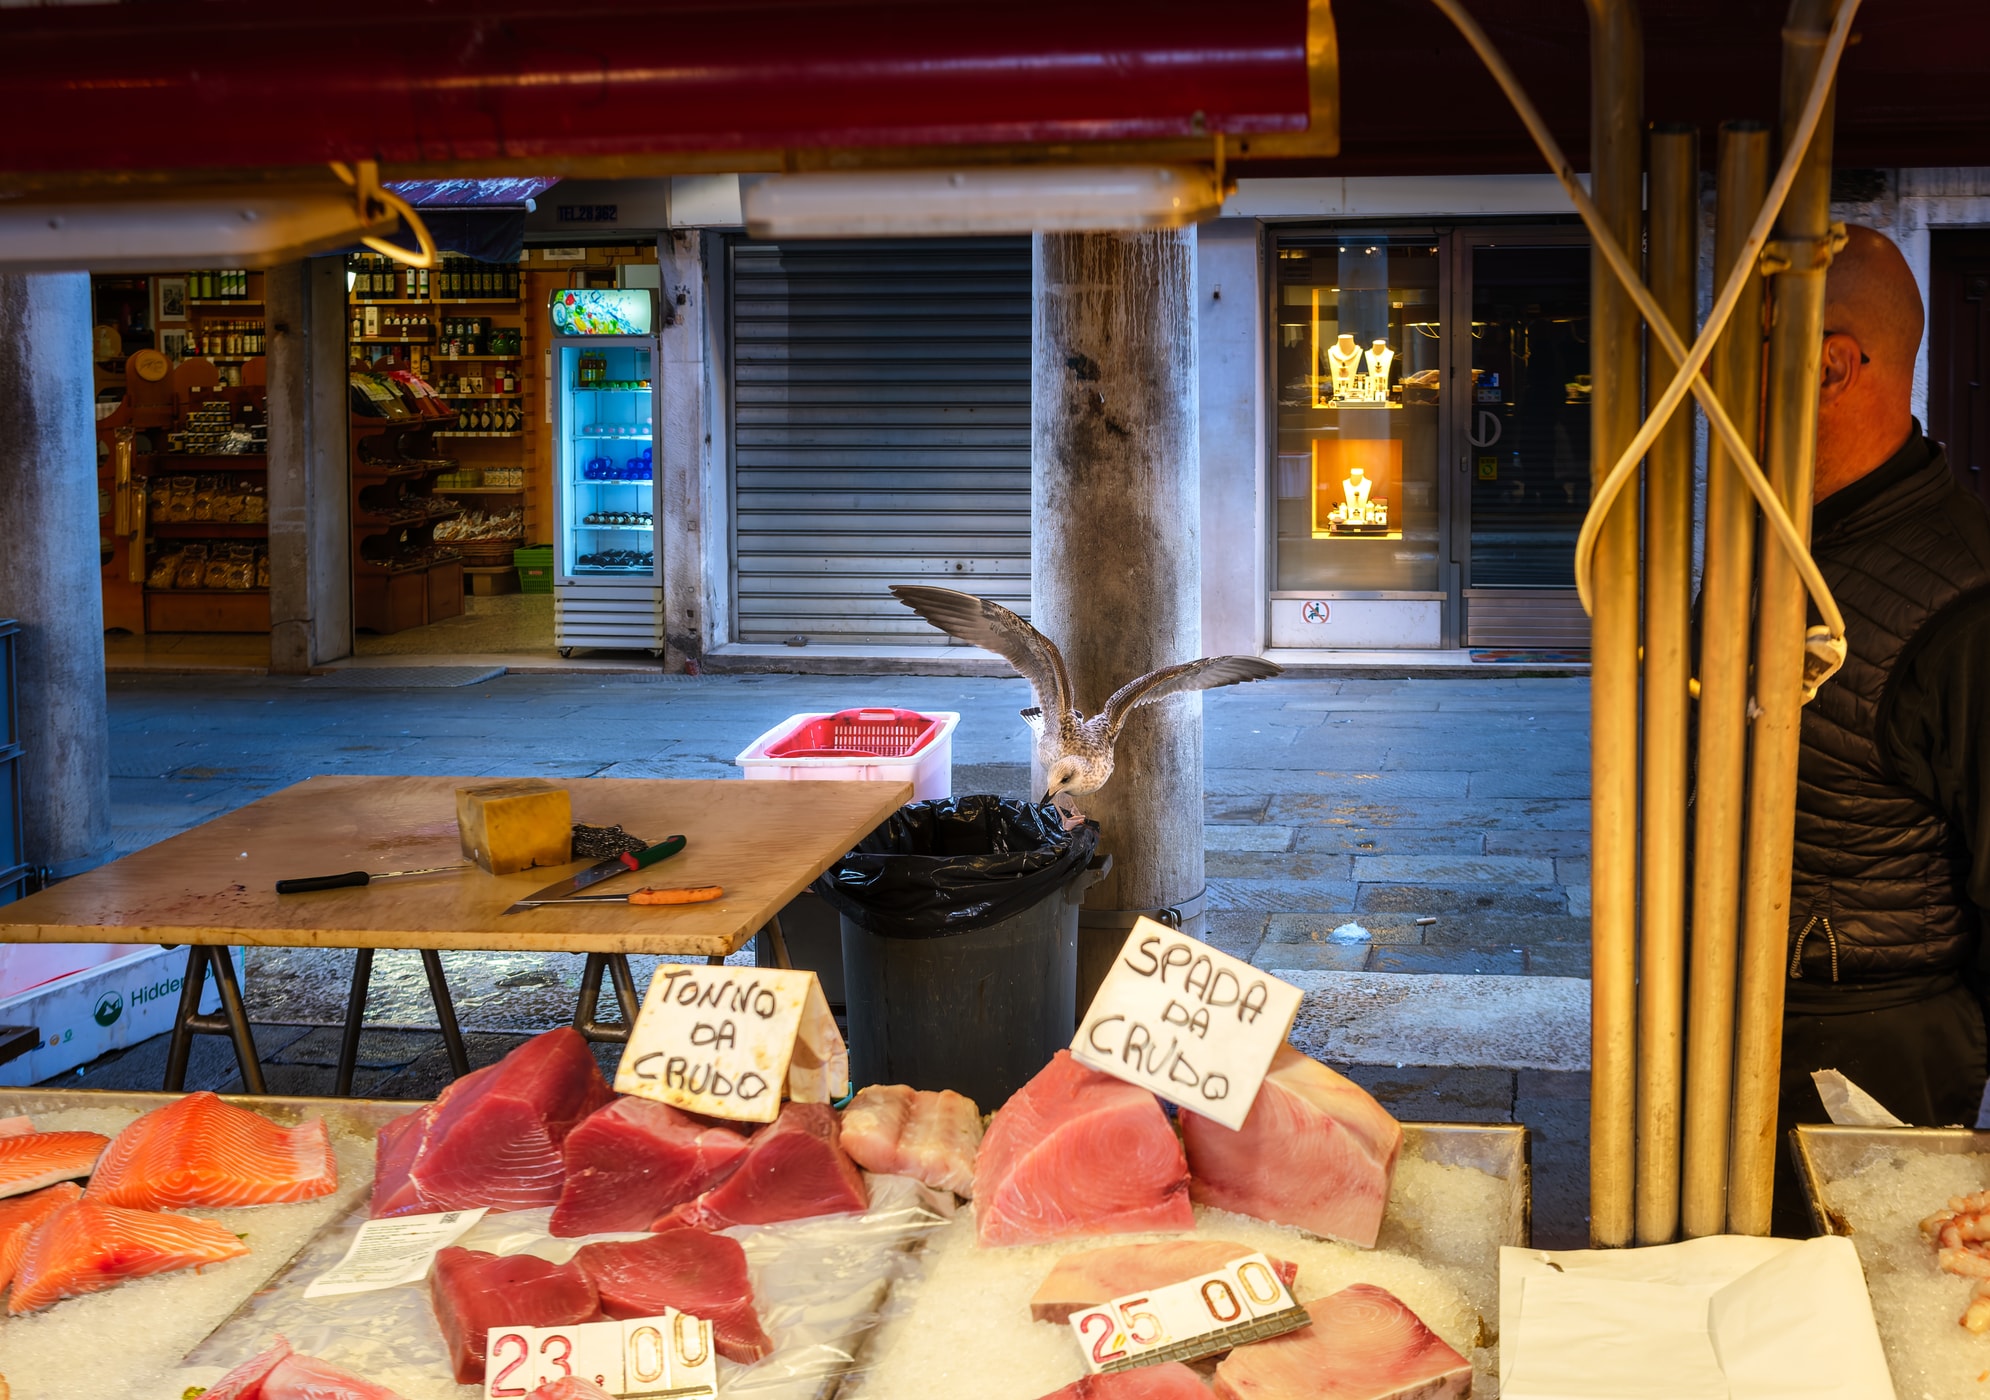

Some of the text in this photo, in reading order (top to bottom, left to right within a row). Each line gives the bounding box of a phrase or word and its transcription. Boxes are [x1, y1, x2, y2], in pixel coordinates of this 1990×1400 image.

[662, 970, 777, 1019] TONNO
[1124, 936, 1267, 1023] SPADA
[690, 1019, 735, 1050] DA
[1161, 1000, 1210, 1039] DA
[633, 1052, 769, 1100] CRUDO
[1089, 1014, 1229, 1100] CRUDO
